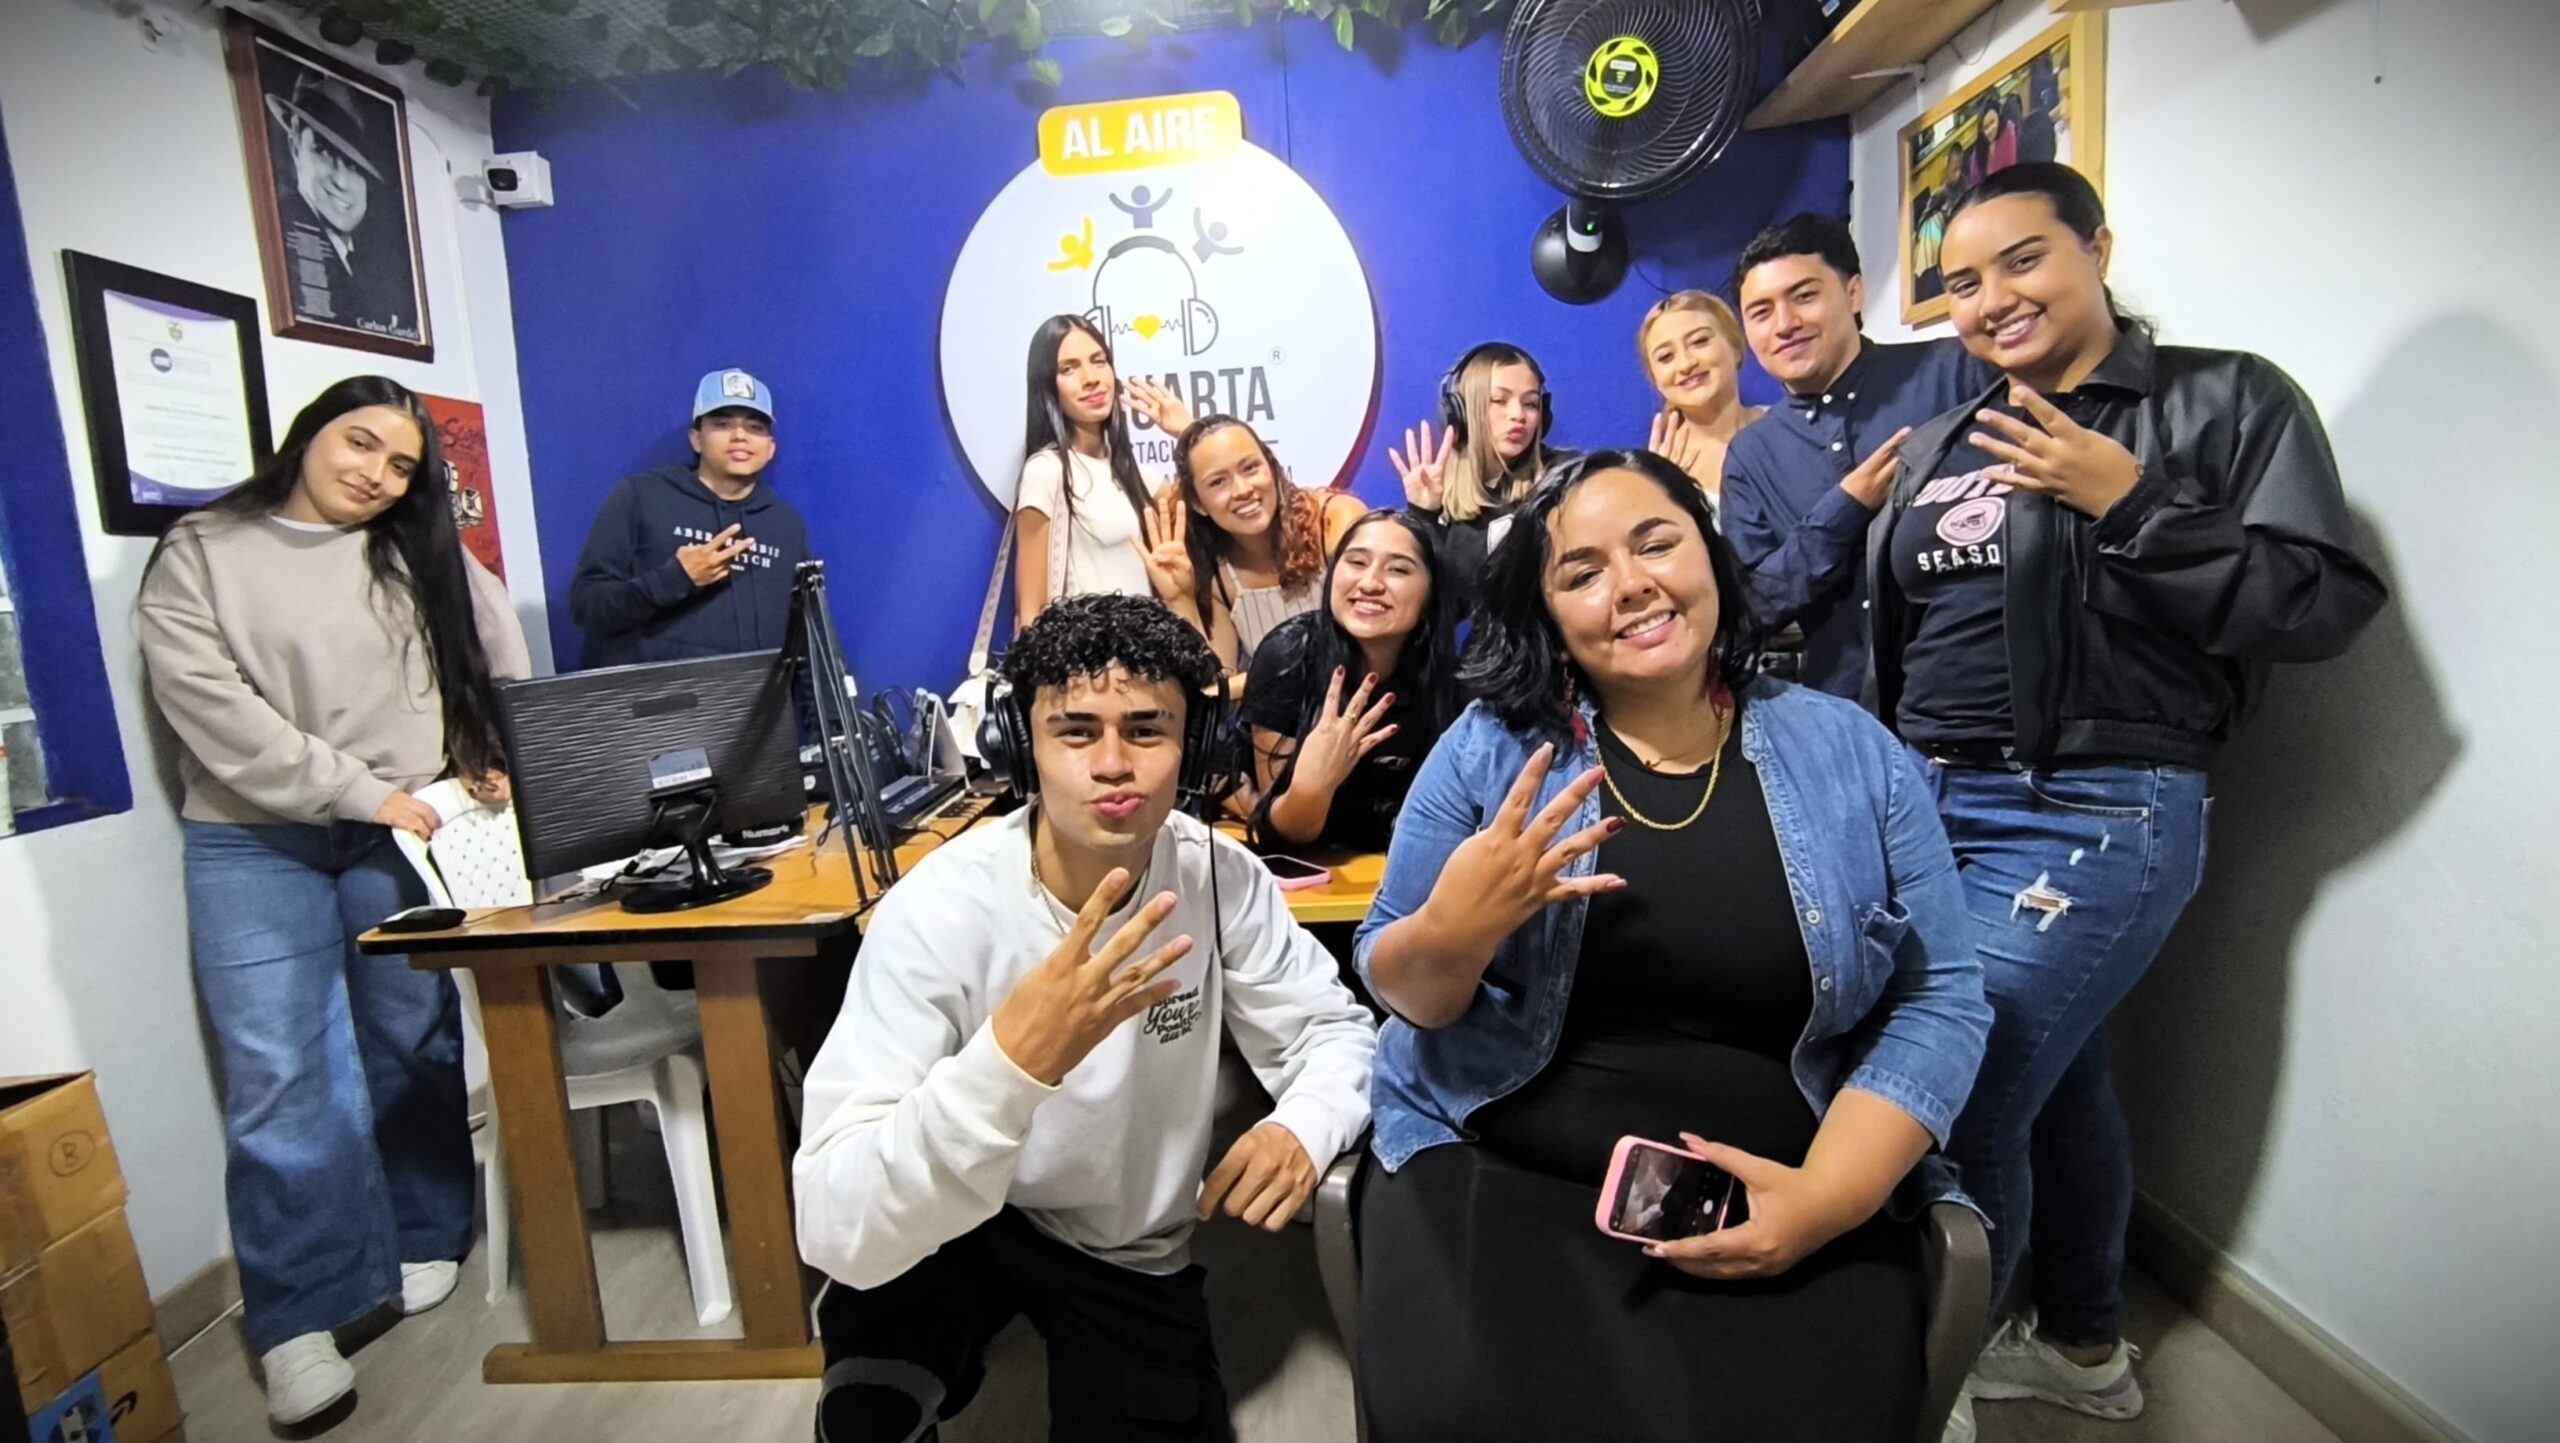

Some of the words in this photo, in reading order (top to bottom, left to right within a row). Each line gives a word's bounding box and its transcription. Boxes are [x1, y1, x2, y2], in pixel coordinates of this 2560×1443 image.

[1062, 117, 1115, 160] AL
[1124, 104, 1218, 155] AIRE
[1128, 366, 1275, 431] UARTA
[1917, 544, 2004, 573] SEASO
[742, 824, 790, 839] Numark
